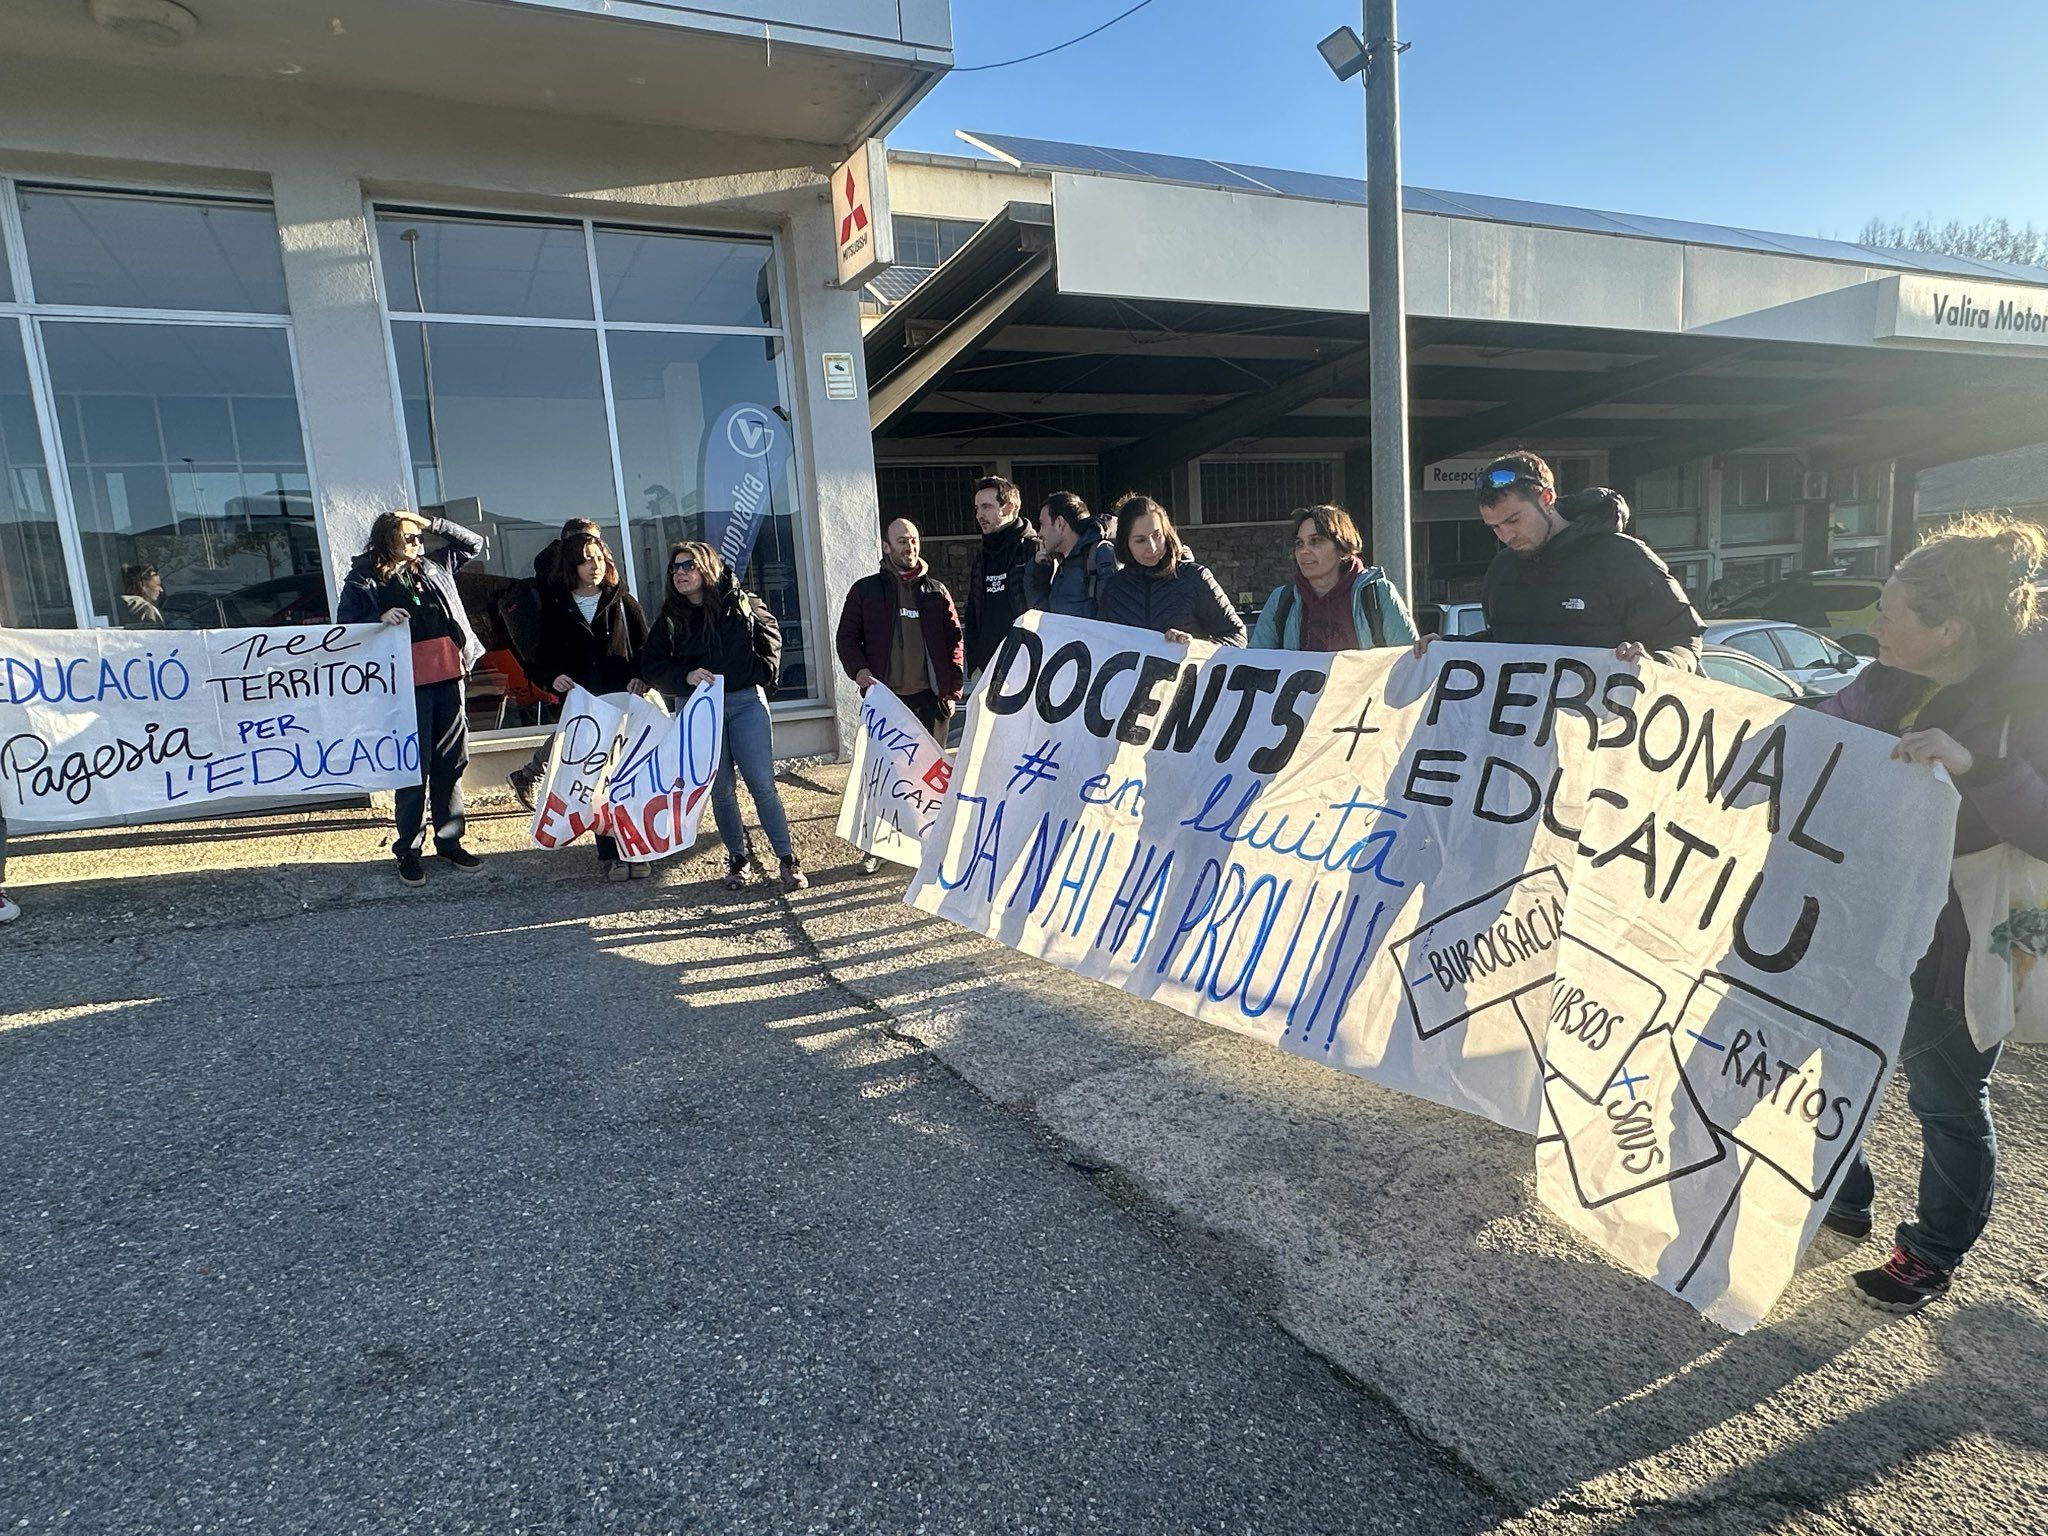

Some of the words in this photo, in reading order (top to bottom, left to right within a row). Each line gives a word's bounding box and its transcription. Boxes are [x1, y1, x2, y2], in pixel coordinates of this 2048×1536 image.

[1933, 293, 1990, 329] Valira
[0, 648, 190, 704] DUCACIÓ
[205, 654, 397, 703] TERRITORI
[0, 722, 212, 805] Pagesia
[165, 729, 418, 801] L'EDUCACIÓ
[238, 714, 310, 748] PER
[984, 626, 1328, 775] DOCENTS
[1426, 657, 1846, 864] PERSONAL
[1079, 774, 1146, 817] en
[1180, 773, 1408, 888] lluita
[937, 792, 1006, 903] JA
[1095, 840, 1176, 964] HA
